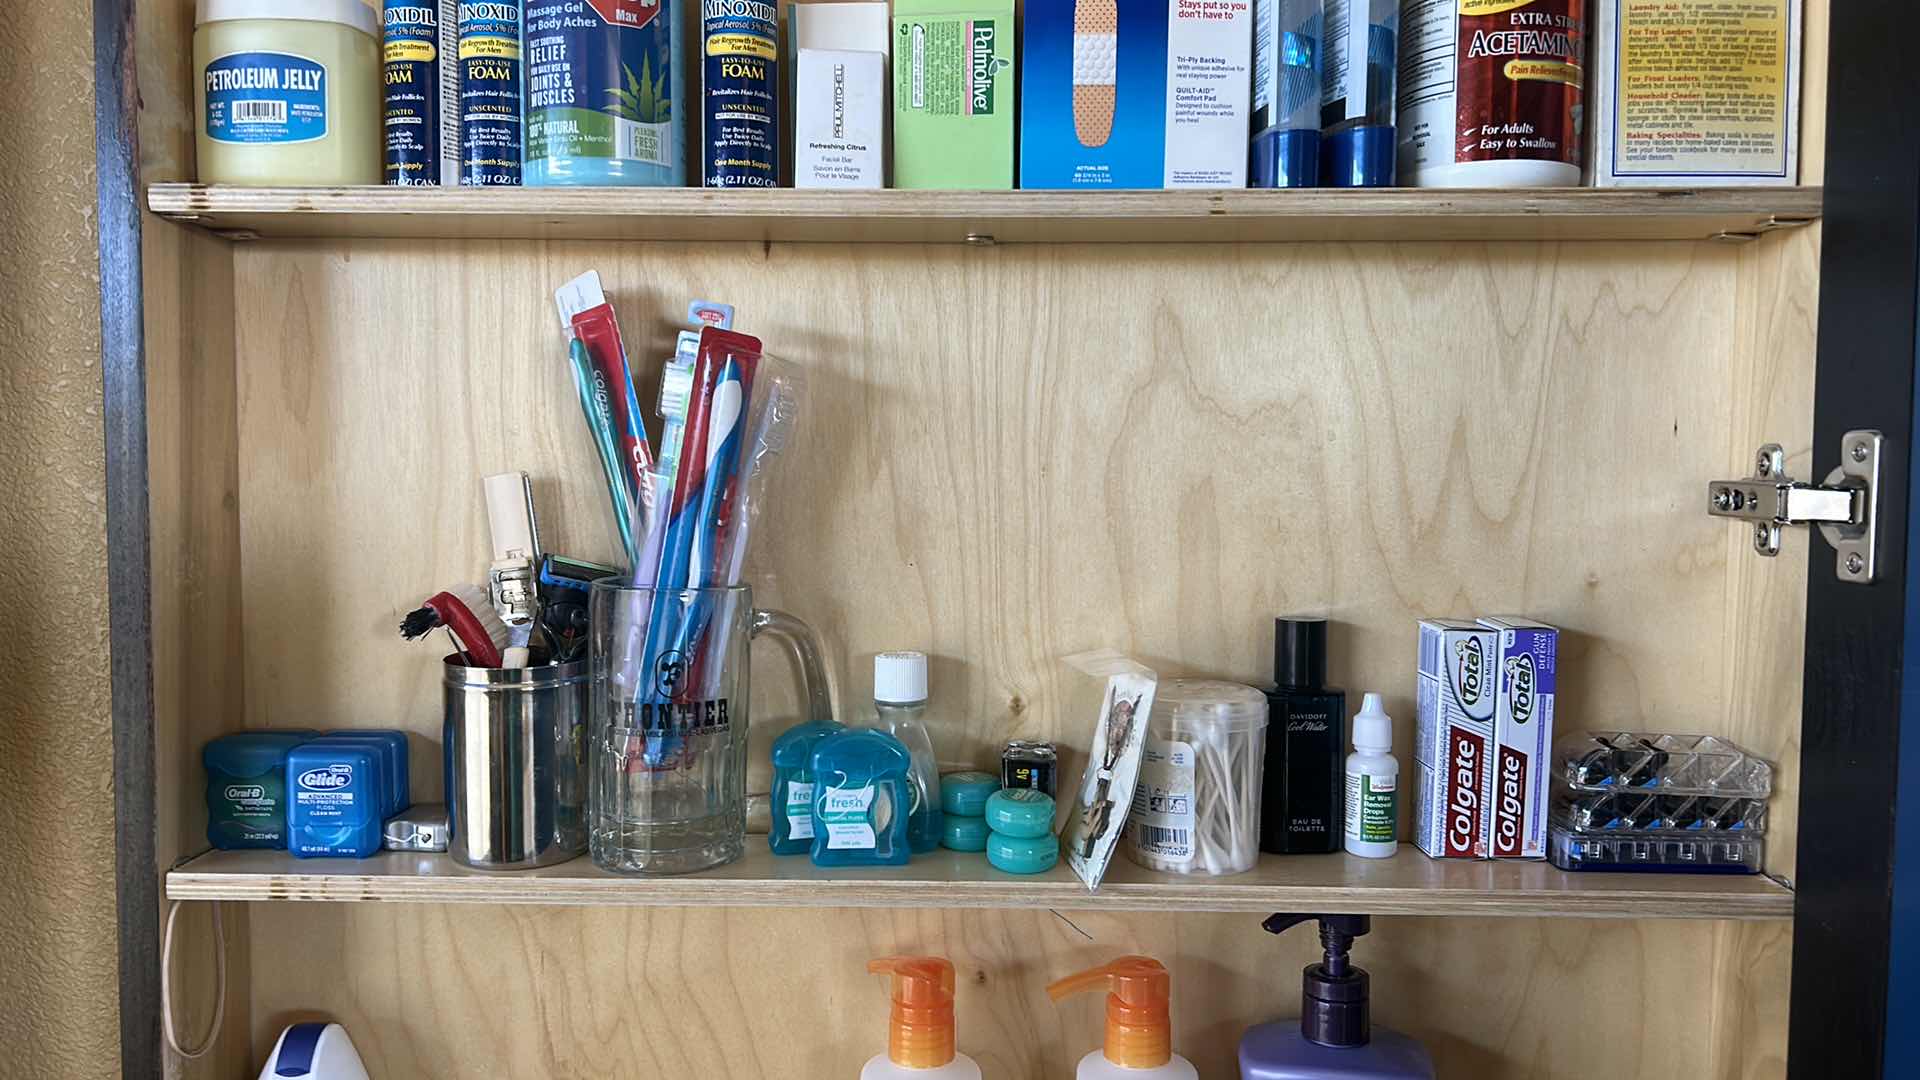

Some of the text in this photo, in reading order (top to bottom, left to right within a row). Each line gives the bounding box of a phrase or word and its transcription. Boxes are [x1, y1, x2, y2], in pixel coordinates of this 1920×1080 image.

[458, 3, 519, 23] INOXID
[527, 2, 583, 19] Massage Gel
[1178, 0, 1202, 11] Stays
[1203, 1, 1218, 12] put
[1231, 3, 1248, 11] you
[384, 6, 437, 26] OXIDIL
[615, 8, 638, 23] Max
[1178, 9, 1234, 20] don't have to
[1510, 13, 1552, 26] EXTRA
[538, 20, 563, 32] Body
[563, 16, 597, 28] Aches
[1467, 29, 1577, 58] ACETAMIN
[530, 44, 567, 65] RELIEF
[1176, 56, 1226, 65] Tri-Ply Backing
[469, 67, 511, 80] FOAM
[722, 64, 764, 80] FOAM
[973, 27, 994, 109] Palmolive
[1510, 65, 1529, 75] Pain
[206, 67, 321, 91] PETROLEUM JELLY
[385, 70, 413, 85] OAM
[531, 72, 572, 93] JOINTS &
[531, 88, 575, 107] MUSCLES
[1175, 94, 1217, 102] Comfort Pad
[468, 104, 512, 113] UNSCENTED
[543, 120, 580, 134] NATURAL
[1481, 123, 1534, 135] For Adults
[809, 142, 867, 151] Refreshing Citrus
[1480, 137, 1557, 151] Easy to Swallow
[593, 369, 610, 433] Colgate
[1533, 632, 1541, 654] GUM
[1539, 632, 1547, 670] DEFENSE
[1462, 643, 1480, 698] Total
[1485, 659, 1493, 676] Mint
[1484, 678, 1492, 698] Clean
[1513, 661, 1531, 716] Total
[303, 772, 345, 786] Glide
[228, 788, 261, 798] Oral-B
[793, 791, 810, 801] fre
[1450, 739, 1478, 852] Colgate
[831, 795, 863, 808] fresh
[1496, 754, 1522, 852] Colgate
